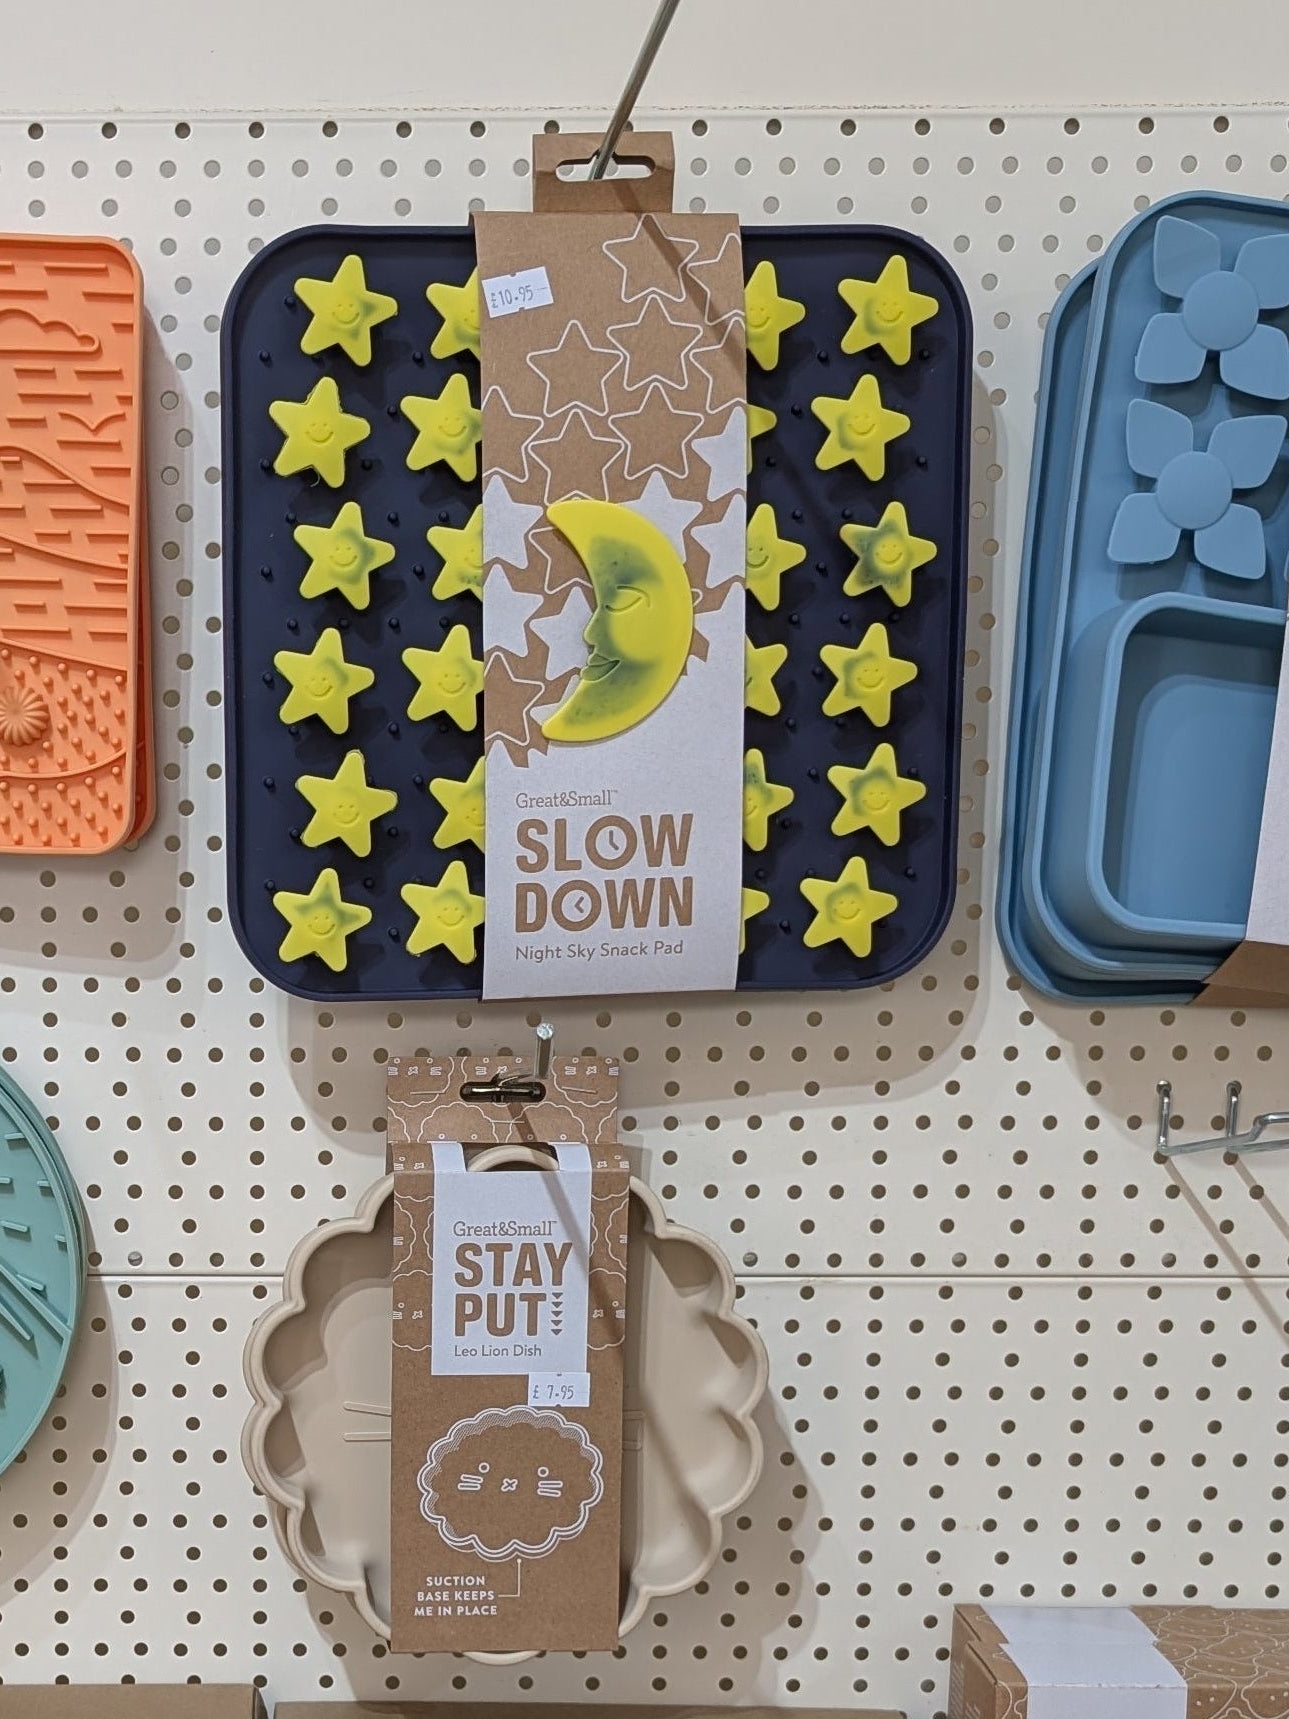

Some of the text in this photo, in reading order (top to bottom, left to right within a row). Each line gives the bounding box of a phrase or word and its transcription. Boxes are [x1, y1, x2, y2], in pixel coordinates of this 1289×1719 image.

[491, 285, 534, 308] £10.95
[516, 813, 694, 873] SLOW
[515, 876, 693, 933] DOWN
[515, 939, 683, 963] Night Sky Snack Pad
[454, 1242, 573, 1287] STAY
[454, 1292, 547, 1337] PUT
[454, 1344, 542, 1357] Leo Lion Dish
[547, 1385, 574, 1400] 7.95
[426, 1576, 485, 1586] SUCTION
[417, 1590, 495, 1601] BASE KEEPS
[414, 1605, 498, 1616] ME IN PLACE
